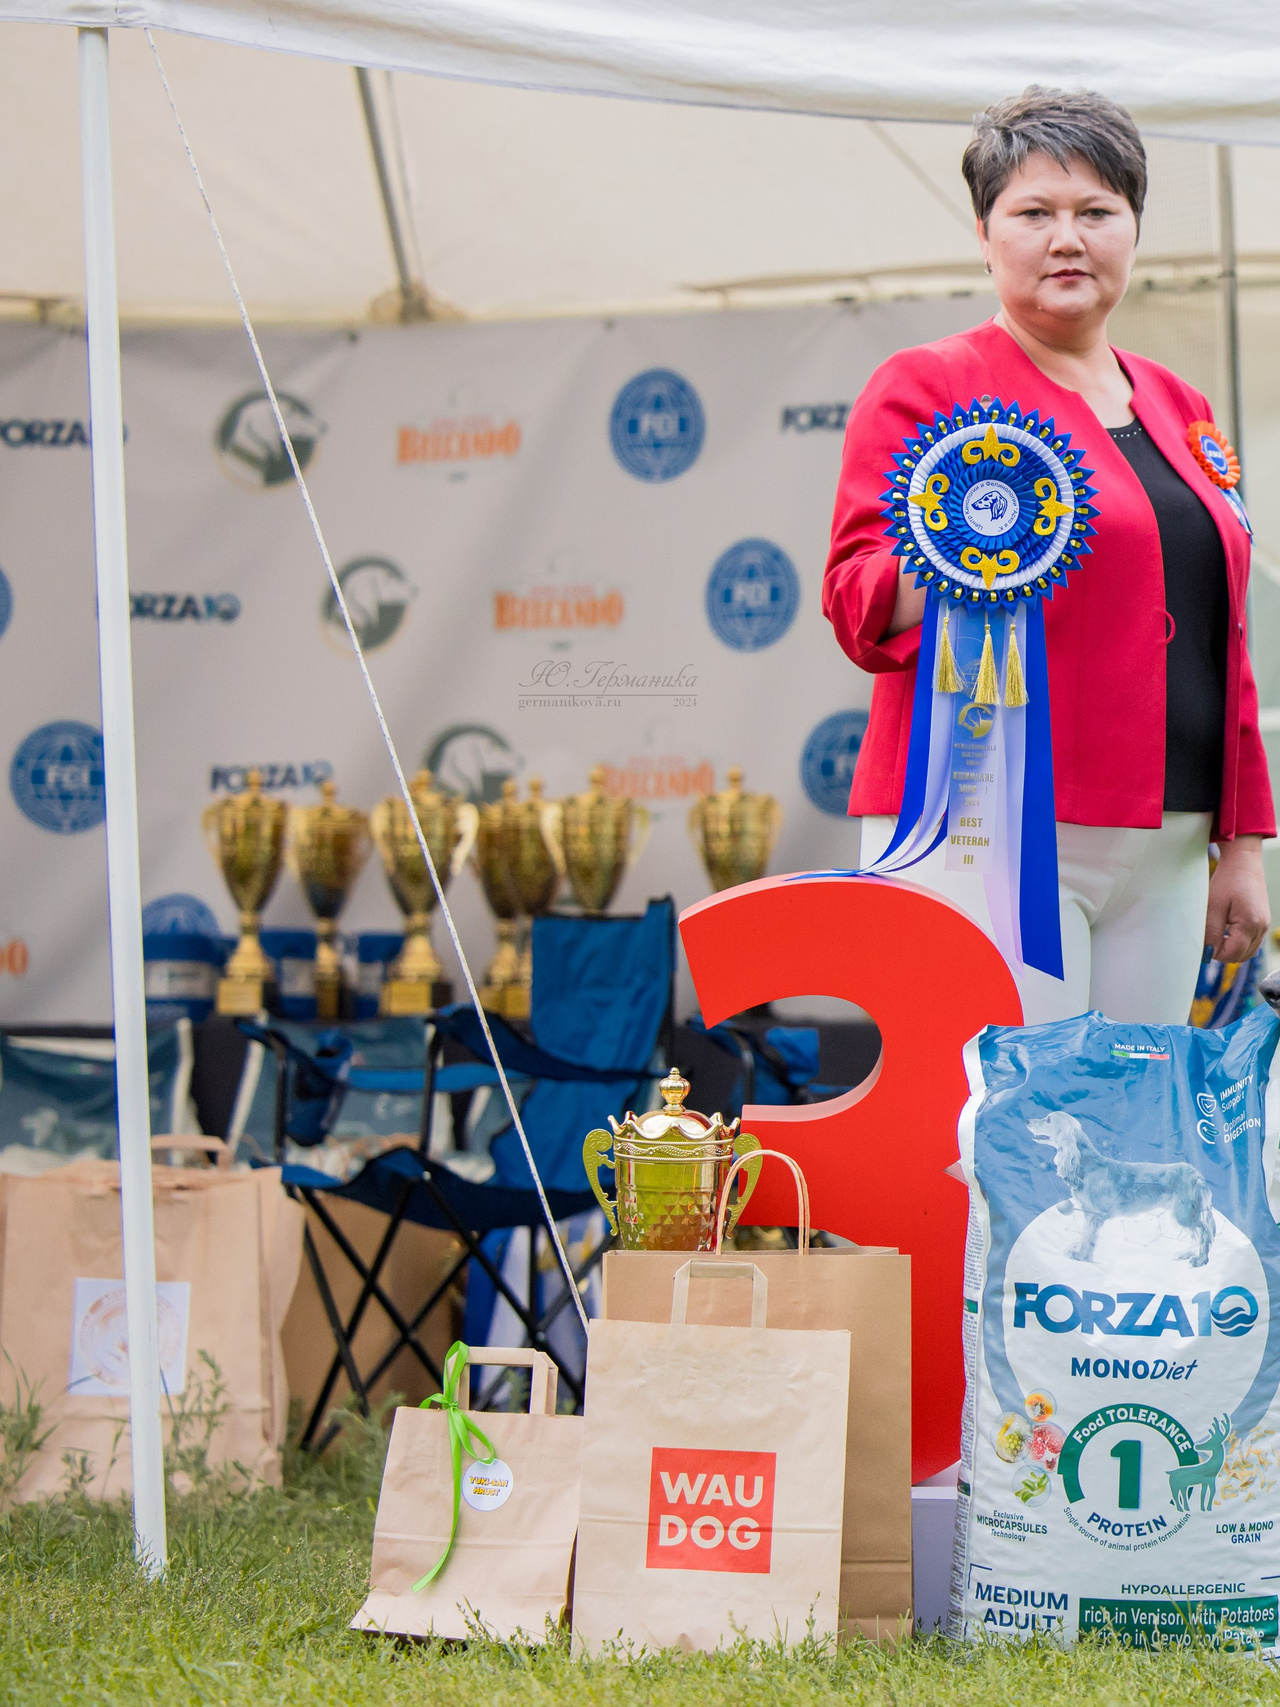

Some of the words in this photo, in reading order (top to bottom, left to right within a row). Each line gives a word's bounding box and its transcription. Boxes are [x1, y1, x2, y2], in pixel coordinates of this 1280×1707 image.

[959, 817, 983, 828] BEST
[950, 834, 990, 847] VETERAN
[963, 854, 974, 865] III
[1114, 1043, 1136, 1051] MADE
[1146, 1045, 1166, 1053] ITALY
[1220, 1074, 1254, 1101] IMMUNITY
[1221, 1091, 1245, 1113] Support
[1223, 1110, 1246, 1132] Optimal
[1223, 1117, 1262, 1143] DIGESTION
[1013, 1281, 1259, 1338] FORZA10
[1072, 1413, 1106, 1445] Food
[1106, 1407, 1192, 1453] TOLERANCE
[469, 1476, 509, 1488] YUKI-SAN
[1110, 1440, 1142, 1509] 1
[659, 1471, 764, 1508] WAU
[976, 1514, 1048, 1535] MICROCAPSULES
[993, 1509, 1024, 1521] Exclusive
[658, 1514, 762, 1551] DOG
[991, 1528, 1027, 1542] Technology
[1063, 1506, 1079, 1528] Single
[1077, 1525, 1099, 1544] source
[1099, 1539, 1108, 1547] of
[1108, 1542, 1132, 1552] animal
[1133, 1539, 1159, 1553] protein
[1158, 1512, 1192, 1544] formulation
[1216, 1523, 1237, 1534] LOW
[1239, 1522, 1246, 1533] &
[1248, 1520, 1274, 1532] MONO
[974, 1581, 1069, 1611] MEDIUM
[1121, 1582, 1246, 1595] HYPOALLERGENIC
[983, 1607, 1057, 1632] ADULT
[1084, 1605, 1111, 1623] rich
[1115, 1606, 1127, 1624] in
[1131, 1606, 1184, 1626] Venison
[1220, 1605, 1275, 1624] Potatoes
